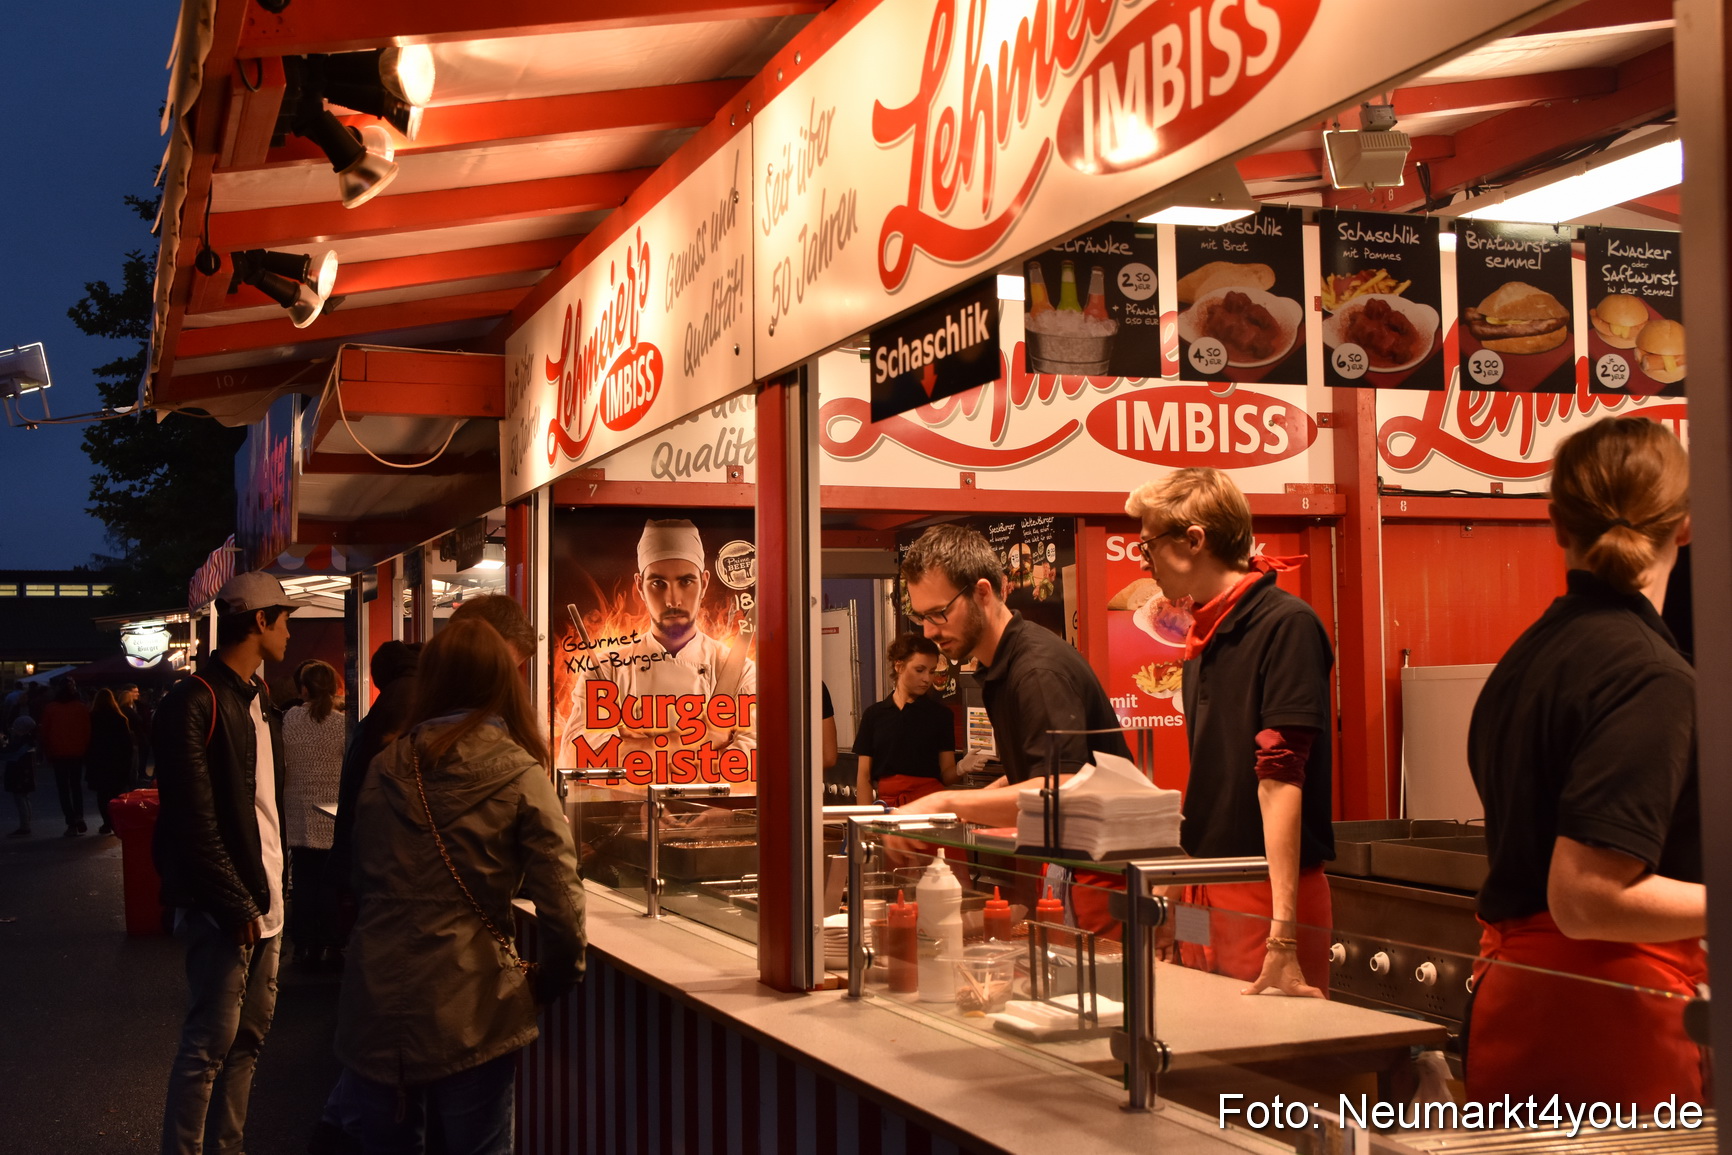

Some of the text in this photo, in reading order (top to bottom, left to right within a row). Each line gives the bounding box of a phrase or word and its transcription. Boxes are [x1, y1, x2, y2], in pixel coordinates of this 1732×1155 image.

[1082, 0, 1282, 174] IMBISS
[762, 97, 836, 237] Seit über
[666, 149, 740, 314] Genuss und
[797, 188, 858, 304] Jahren
[1201, 239, 1249, 252] mit Brot
[1343, 249, 1360, 259] mit
[1485, 251, 1542, 270] semmel
[1631, 260, 1649, 268] oder
[1620, 284, 1638, 295] der
[1642, 285, 1674, 297] Semmel
[1145, 317, 1159, 326] EUR
[874, 300, 990, 385] Schaschlik
[606, 350, 655, 424] IMBISS
[1115, 400, 1290, 455] IMBISS
[589, 484, 597, 497] 7
[1302, 497, 1310, 510] 8
[1400, 500, 1407, 512] 8
[727, 557, 750, 565] Prime
[727, 562, 752, 572] BEEF
[734, 592, 756, 611] 18
[562, 629, 642, 653] Gourmet
[564, 650, 670, 674] XXL-Burger
[572, 734, 757, 786] Meiste
